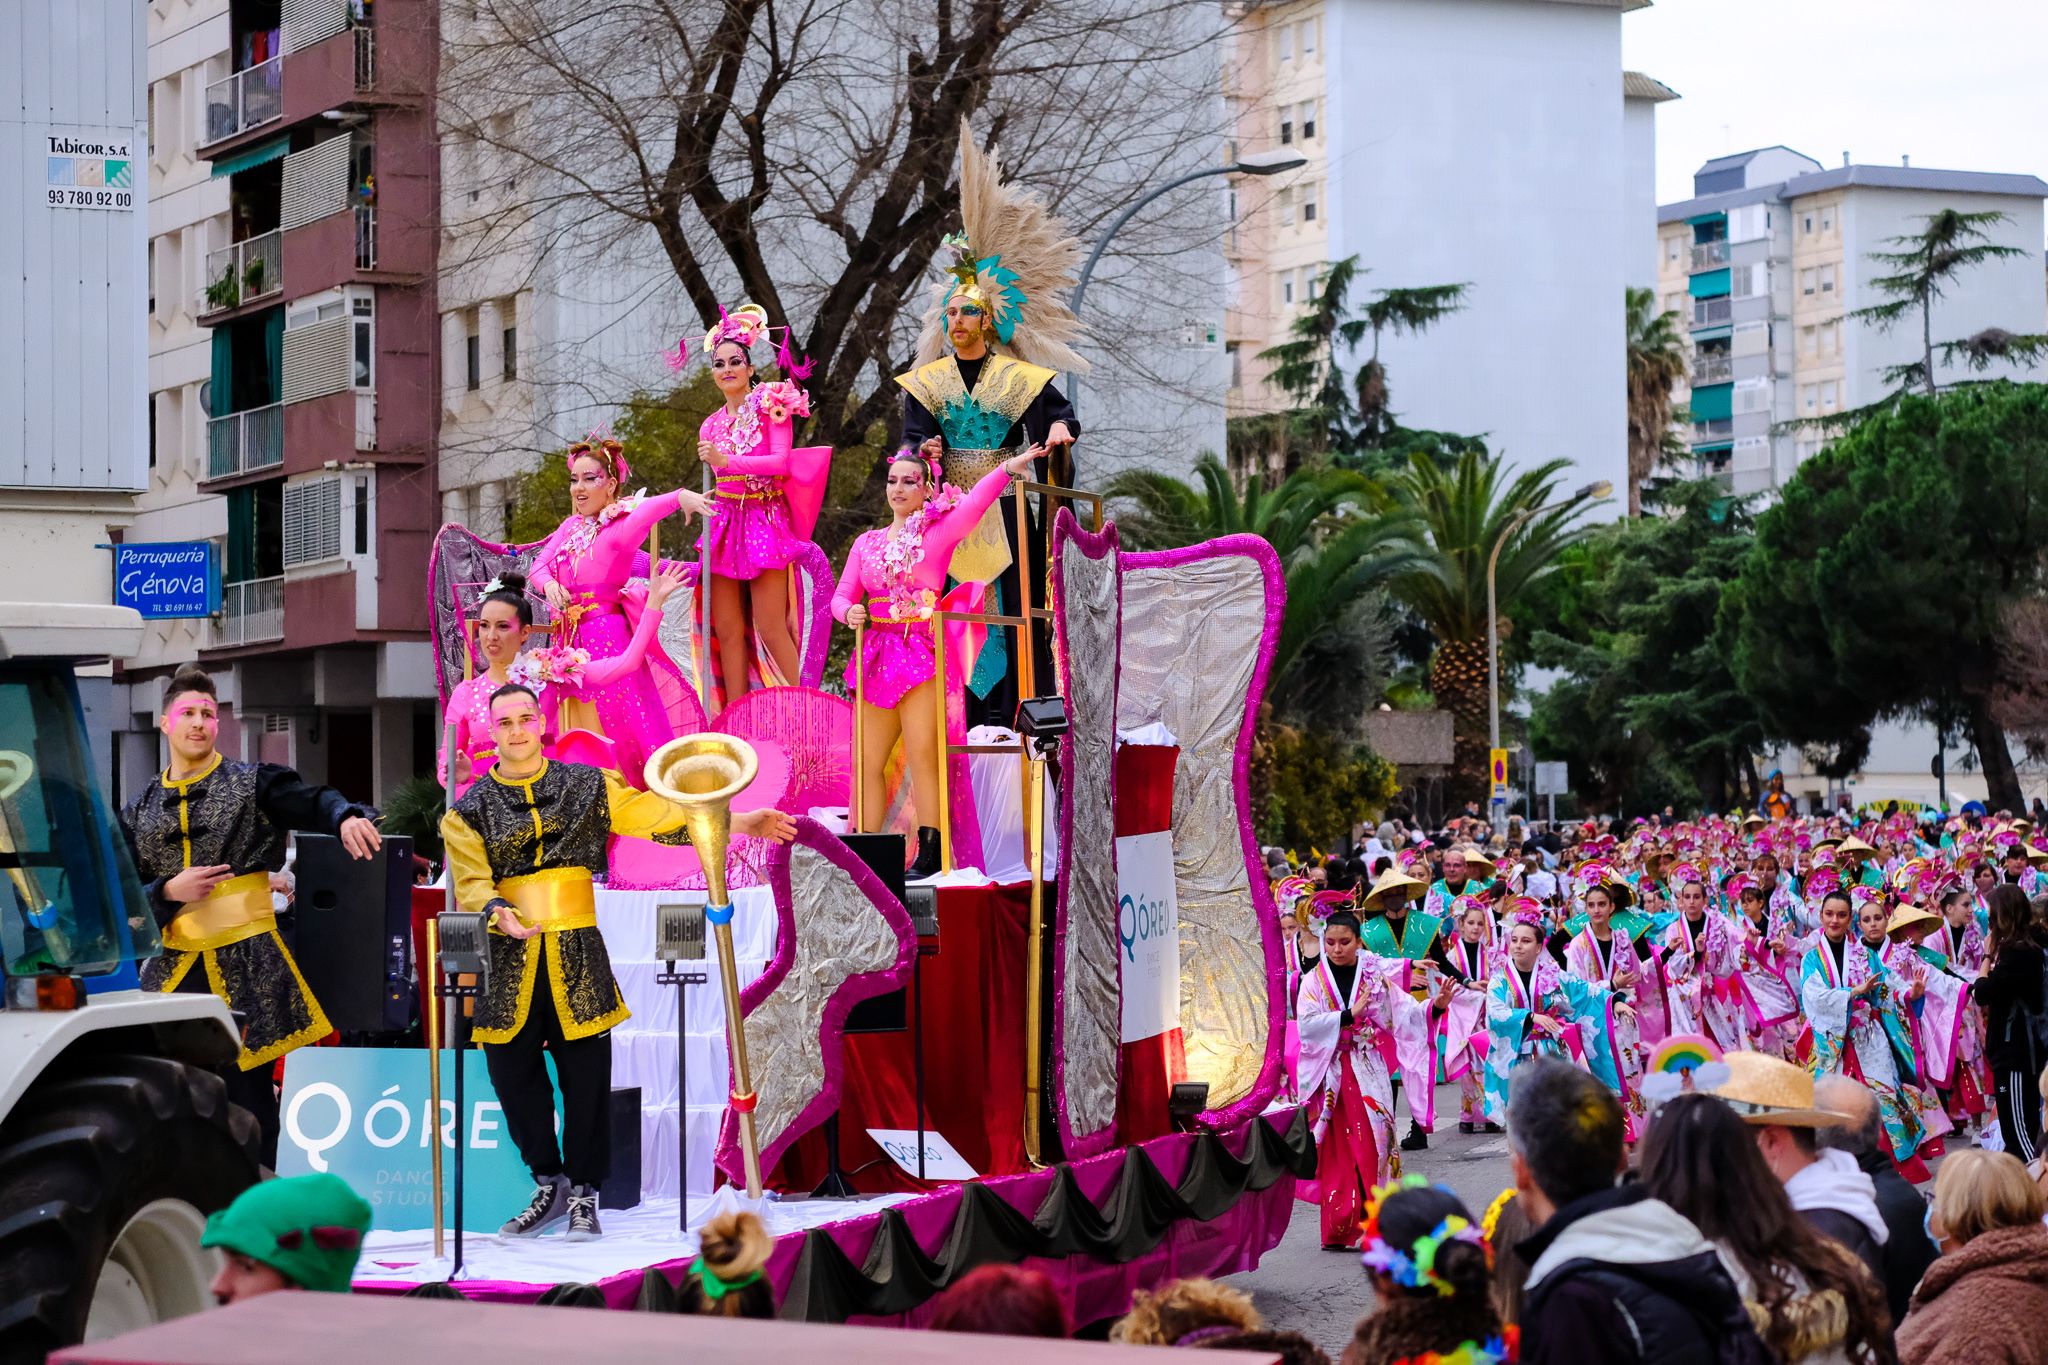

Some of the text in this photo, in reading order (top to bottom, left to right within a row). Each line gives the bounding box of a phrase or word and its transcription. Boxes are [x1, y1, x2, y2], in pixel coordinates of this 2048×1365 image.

[48, 190, 131, 207] 93 780 92 00
[120, 570, 204, 602] Génova
[173, 604, 185, 612] 691
[186, 604, 193, 612] 16
[194, 603, 203, 612] 47
[1119, 892, 1170, 964] QÓREO
[286, 1081, 560, 1173] QÓRE
